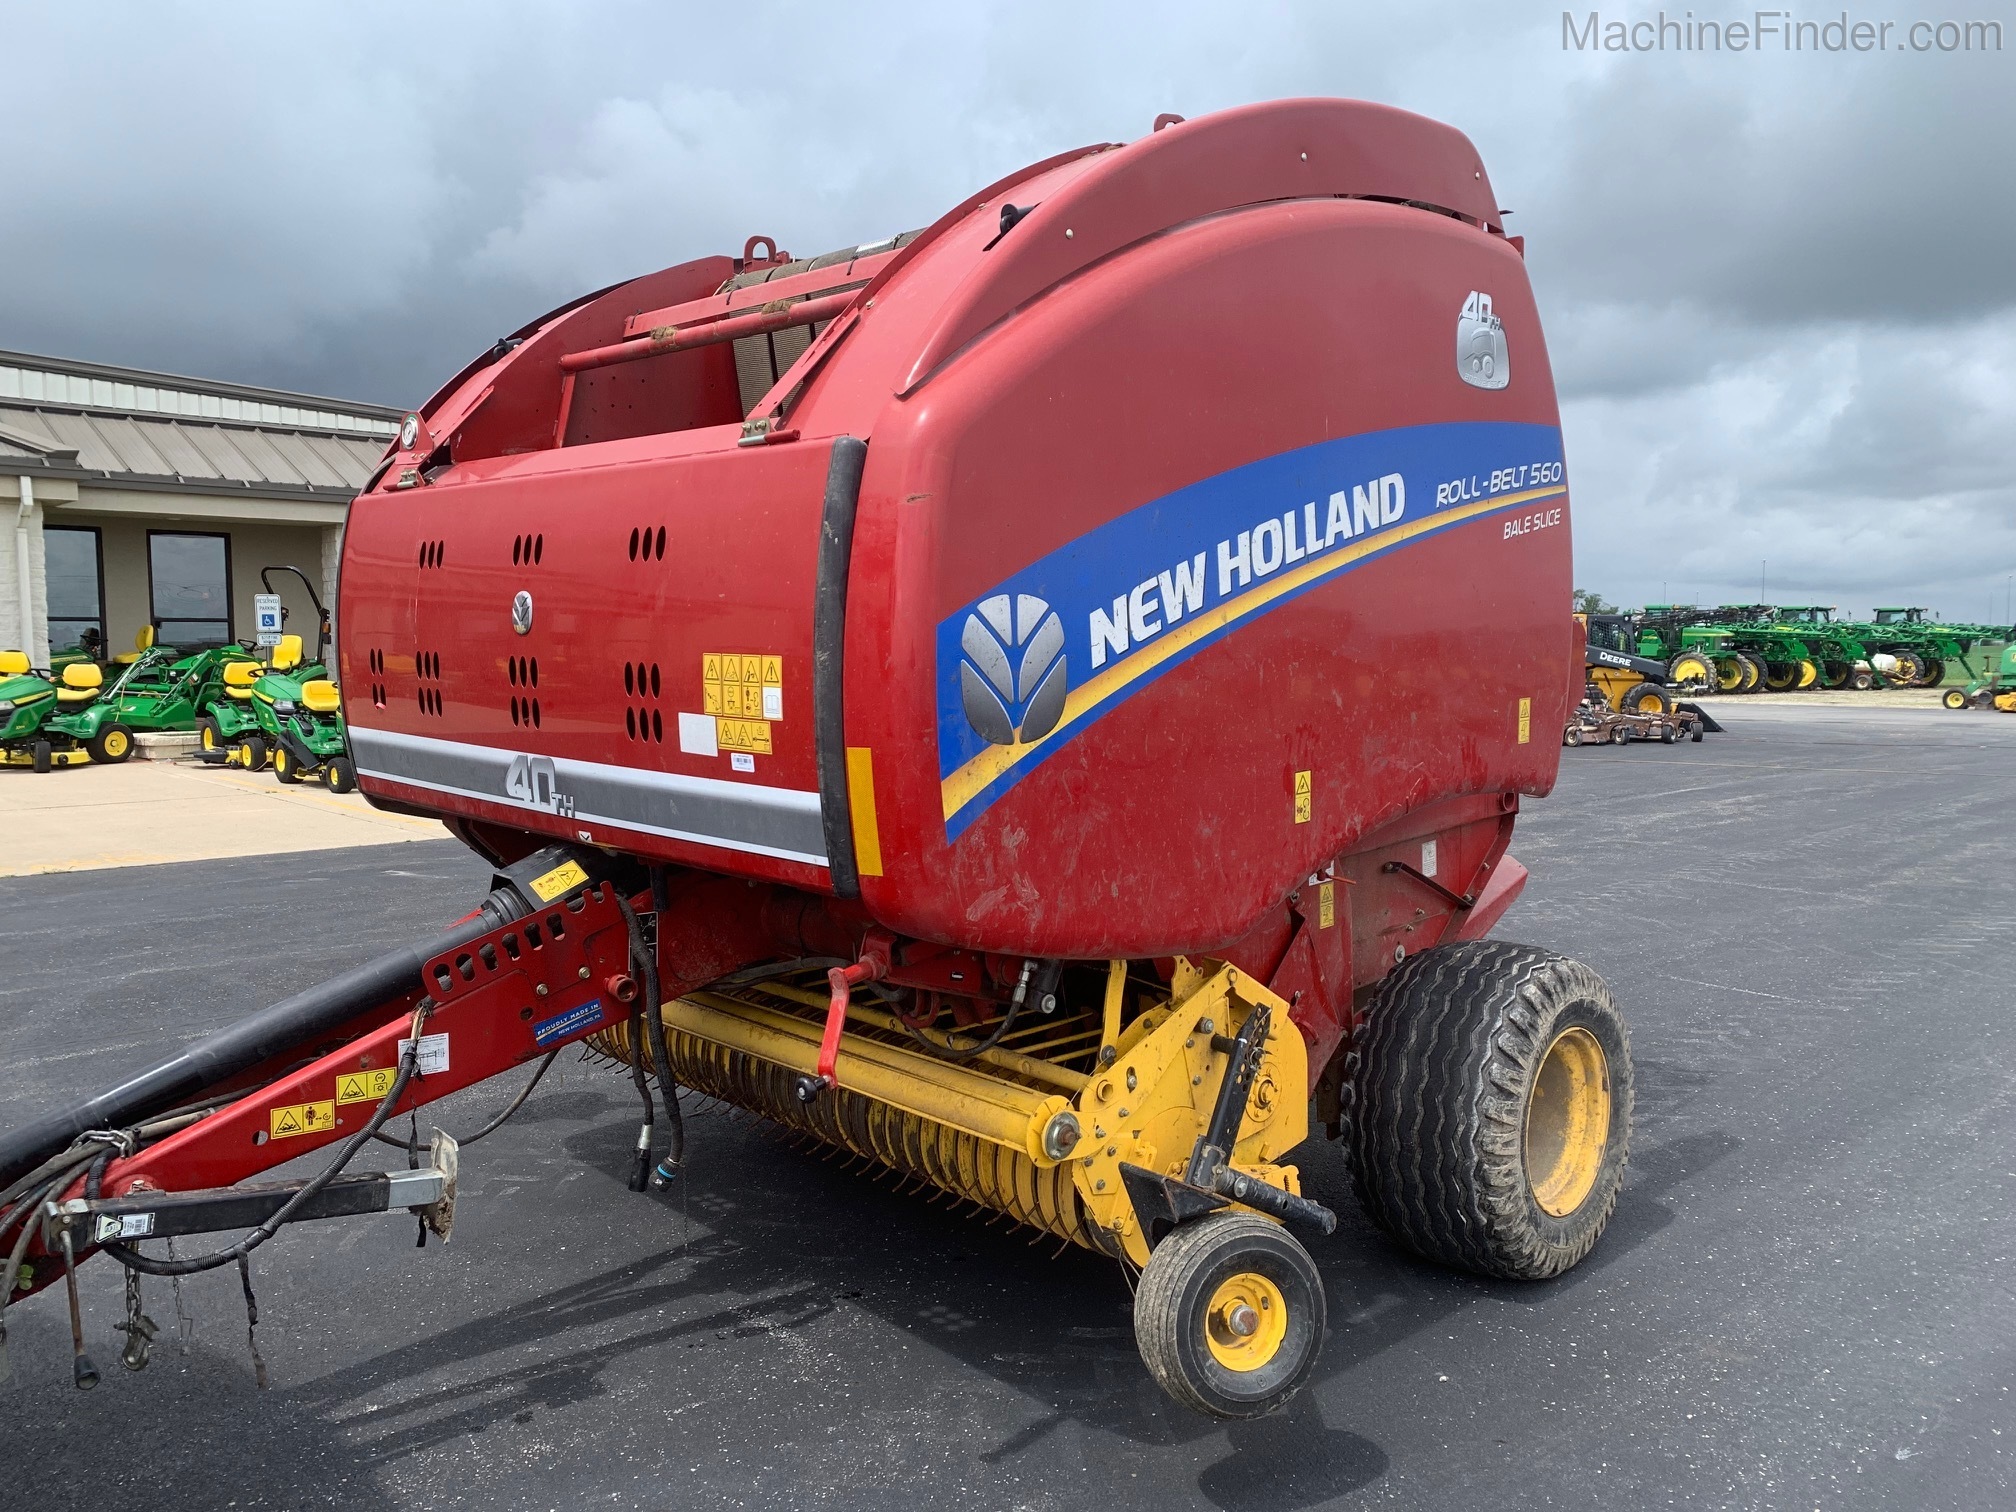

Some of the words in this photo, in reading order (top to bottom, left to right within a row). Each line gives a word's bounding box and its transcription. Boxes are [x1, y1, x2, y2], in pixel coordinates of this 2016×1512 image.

[1436, 466, 1528, 508] ROLL-BELT
[1529, 461, 1562, 486] 560
[1503, 516, 1531, 540] BALE
[1533, 508, 1561, 531] SLICE
[1089, 552, 1206, 670] NEW
[1217, 472, 1406, 597] HOLLAND
[1600, 651, 1631, 667] DEERE
[537, 1017, 568, 1036] PROUDLY
[570, 1008, 589, 1020] MADE
[558, 1027, 570, 1035] NEW
